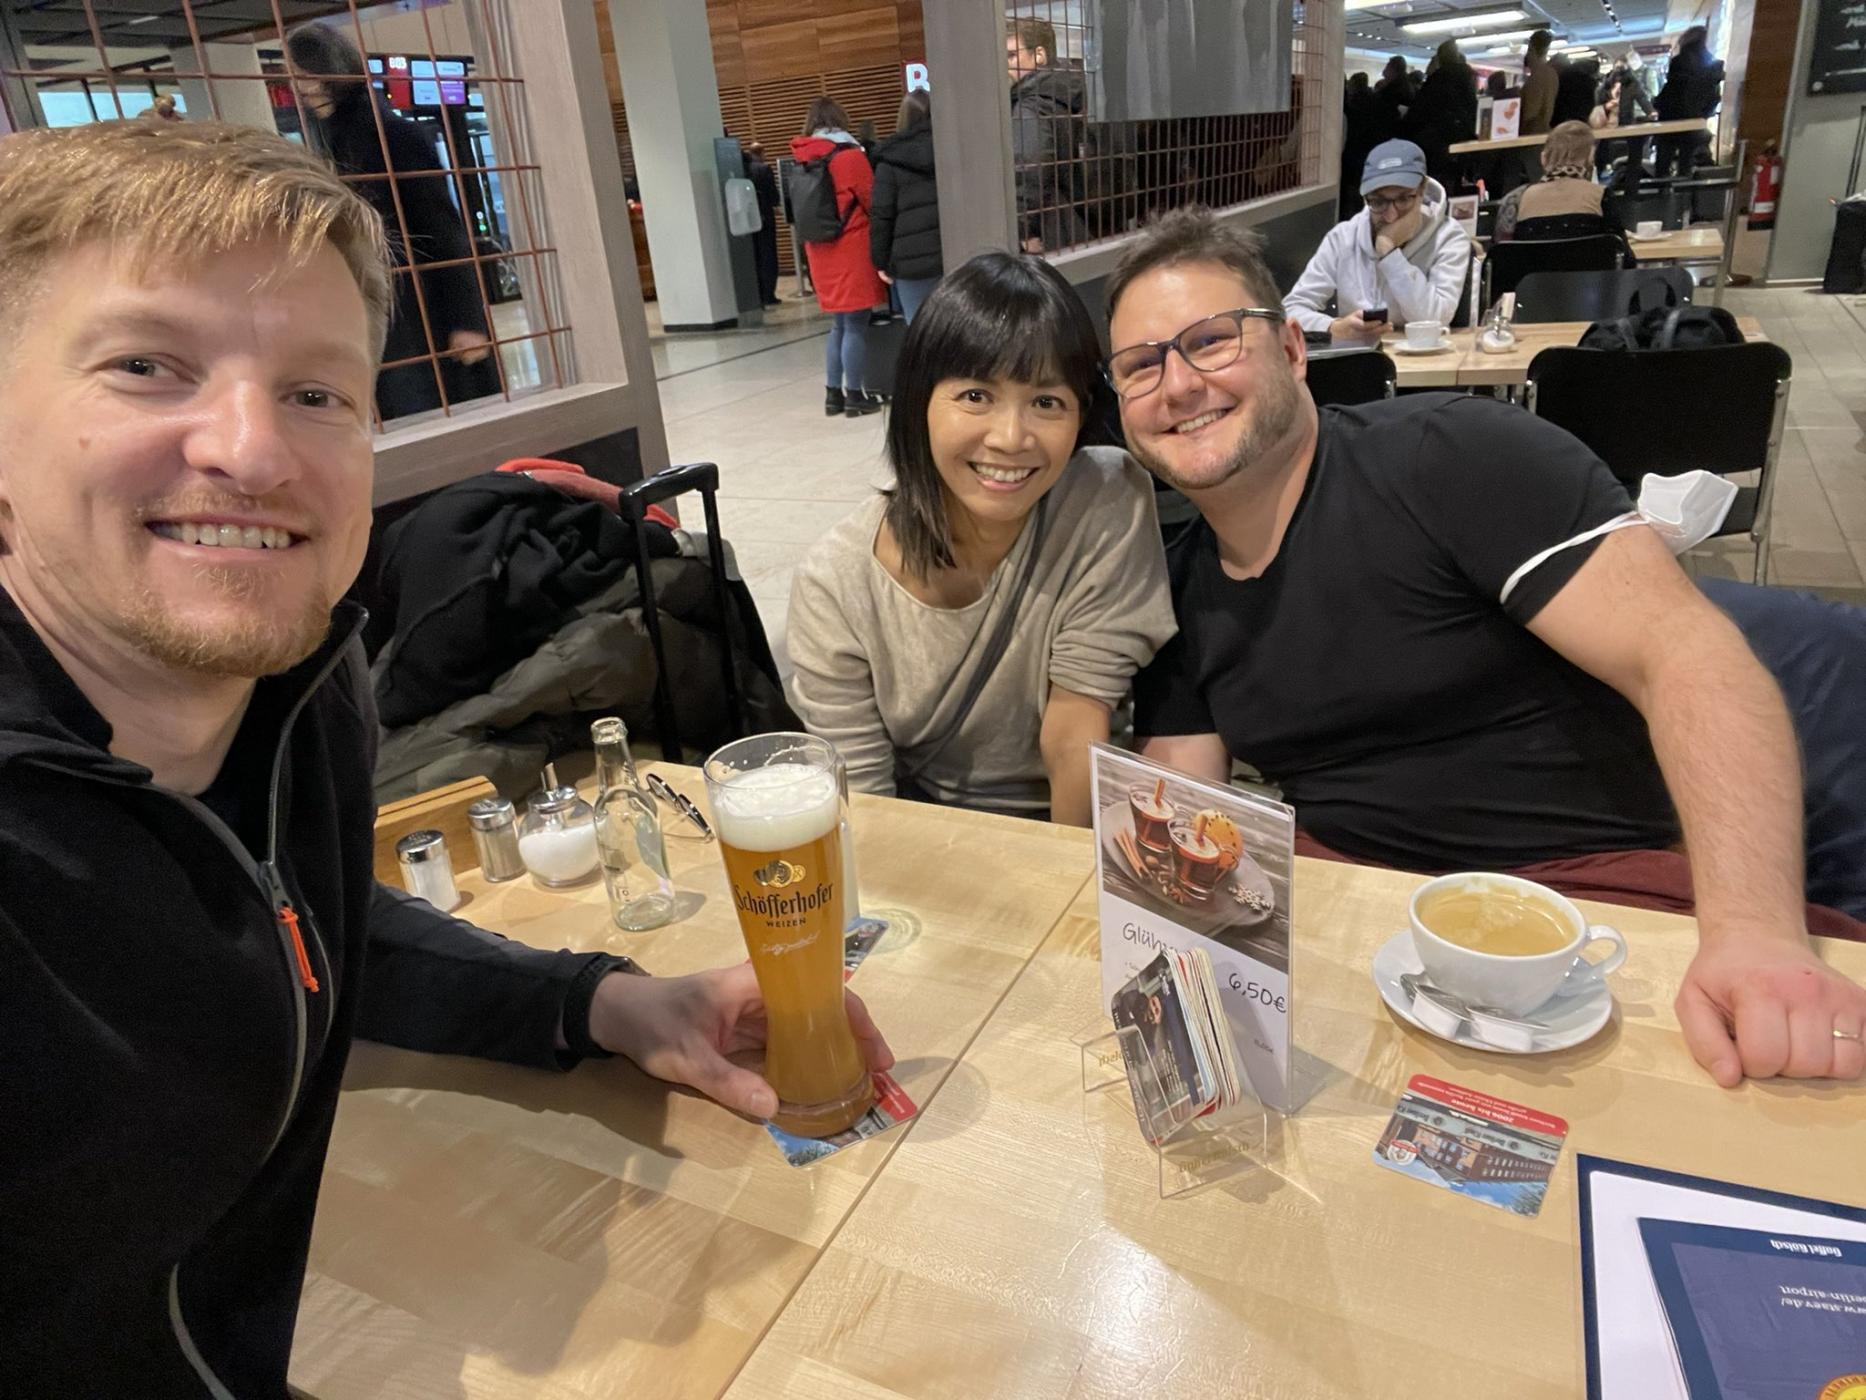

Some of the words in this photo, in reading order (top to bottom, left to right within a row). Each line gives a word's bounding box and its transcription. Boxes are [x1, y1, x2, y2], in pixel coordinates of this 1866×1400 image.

[735, 883, 833, 918] Schöfferhofer
[766, 918, 806, 928] WEIZEN
[1122, 922, 1177, 952] Glüh
[1228, 972, 1287, 1013] 6,50€
[1808, 1244, 1842, 1257] Gaffel
